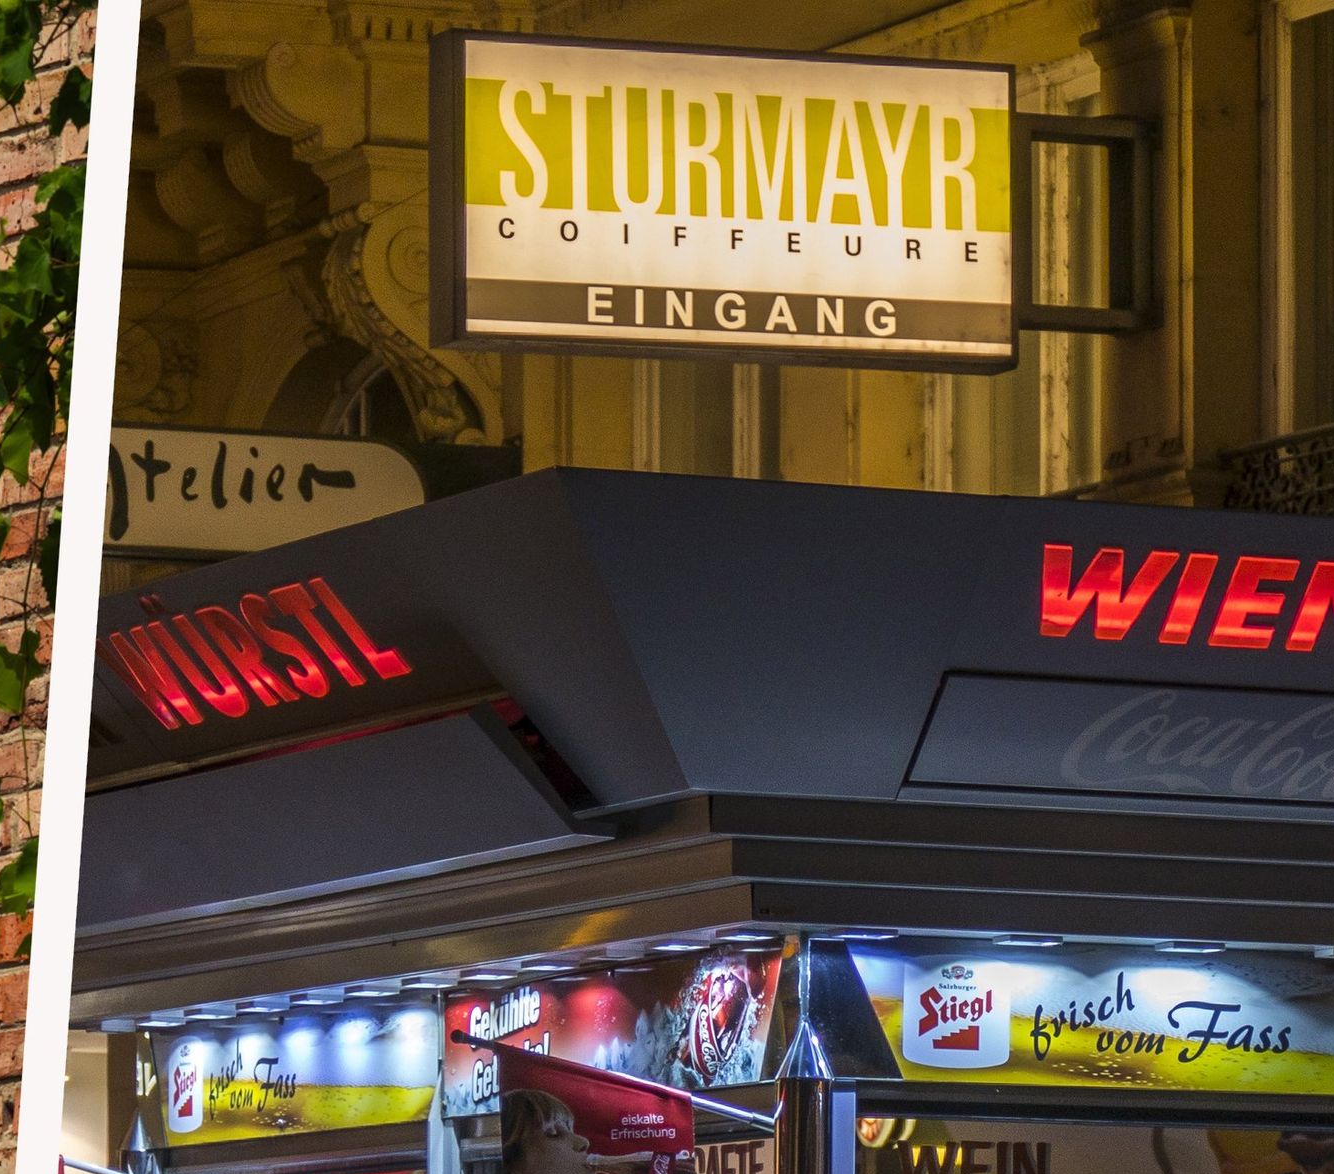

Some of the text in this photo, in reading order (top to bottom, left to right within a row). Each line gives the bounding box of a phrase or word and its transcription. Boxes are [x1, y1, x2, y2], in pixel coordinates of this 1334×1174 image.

[498, 79, 979, 232] STURMAYR
[498, 217, 979, 264] COIFFEURE
[586, 286, 897, 337] EINGANG
[97, 577, 413, 731] WÜRSTL
[918, 986, 993, 1037] Stiegl
[939, 983, 977, 992] Salzburger
[1030, 971, 1136, 1062] frisch
[1096, 1000, 1292, 1063] vom Fass
[209, 1037, 243, 1121] frisch
[253, 1057, 297, 1113] Fass
[610, 1127, 676, 1141] Erfrischung
[621, 1113, 665, 1126] eiskalte
